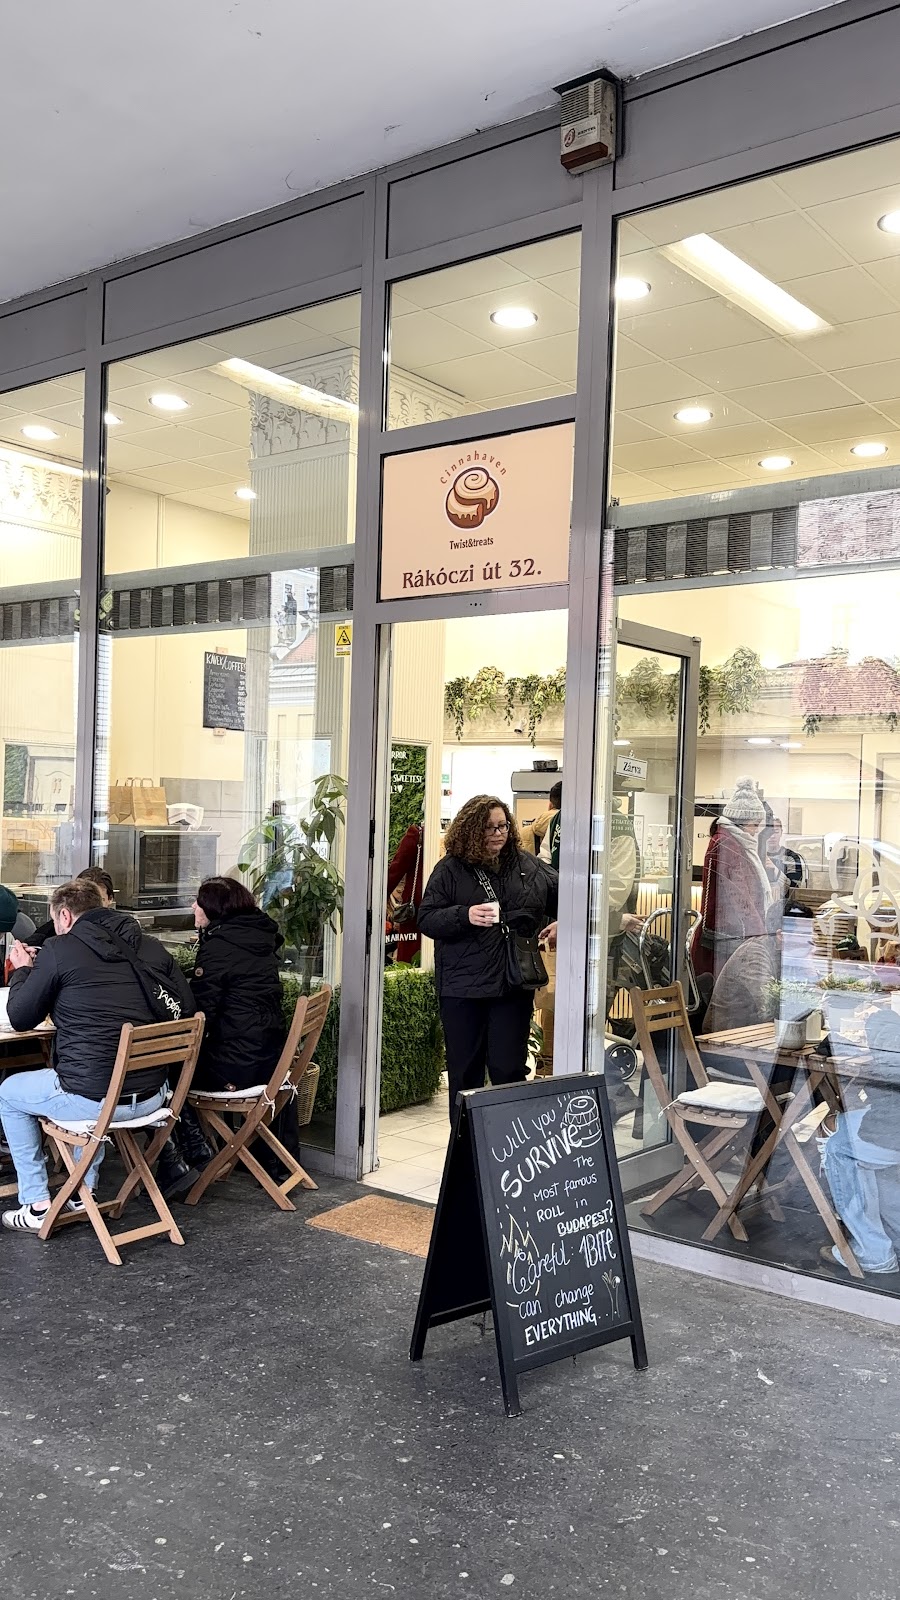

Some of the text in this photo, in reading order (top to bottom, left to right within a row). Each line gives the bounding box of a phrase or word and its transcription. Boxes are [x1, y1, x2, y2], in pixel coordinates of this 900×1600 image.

[449, 536, 494, 550] Twist&treats
[402, 558, 542, 589] Rákóczi út 32.
[391, 751, 408, 759] RROR
[623, 761, 642, 775] Zárva
[392, 774, 423, 783] SWEETEST
[385, 932, 418, 944] NAHAVEN
[491, 1109, 556, 1163] Will you
[573, 1155, 595, 1169] The
[563, 1173, 598, 1197] famous
[536, 1198, 588, 1223] ROLL in
[556, 1199, 614, 1237] BUDAPEST?
[518, 1283, 595, 1320] can change
